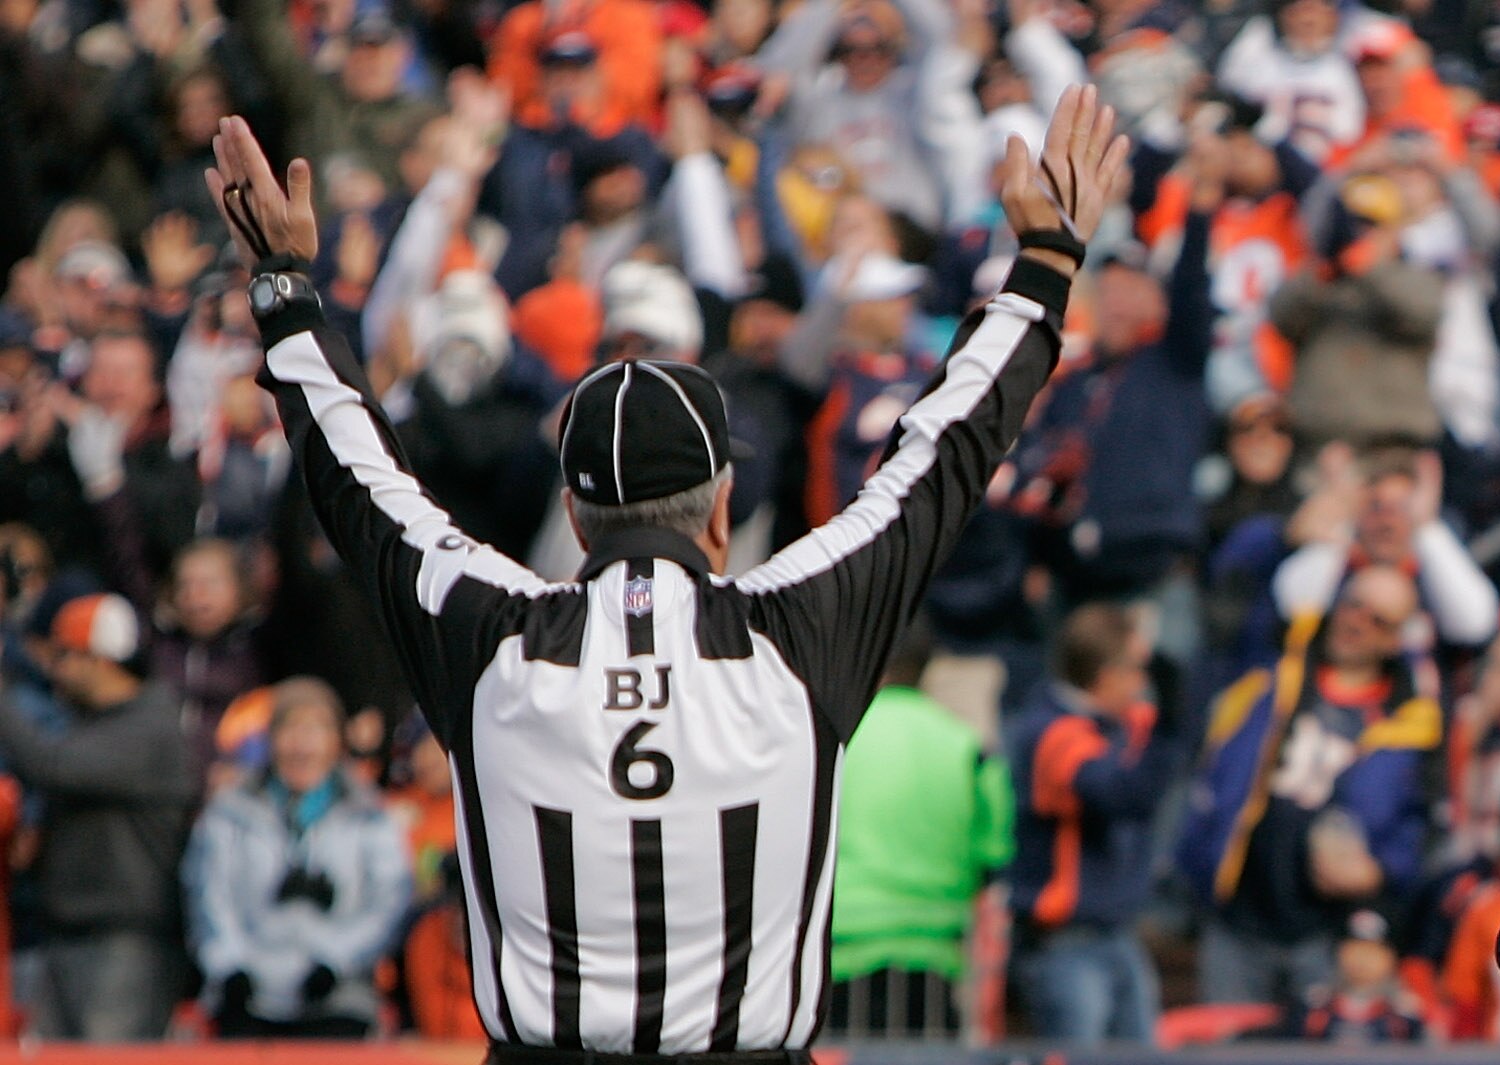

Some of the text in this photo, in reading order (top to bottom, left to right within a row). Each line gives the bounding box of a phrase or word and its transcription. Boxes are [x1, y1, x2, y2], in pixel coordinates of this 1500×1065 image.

[625, 591, 651, 609] NFL
[603, 663, 672, 710] BJ
[608, 718, 674, 800] 6
